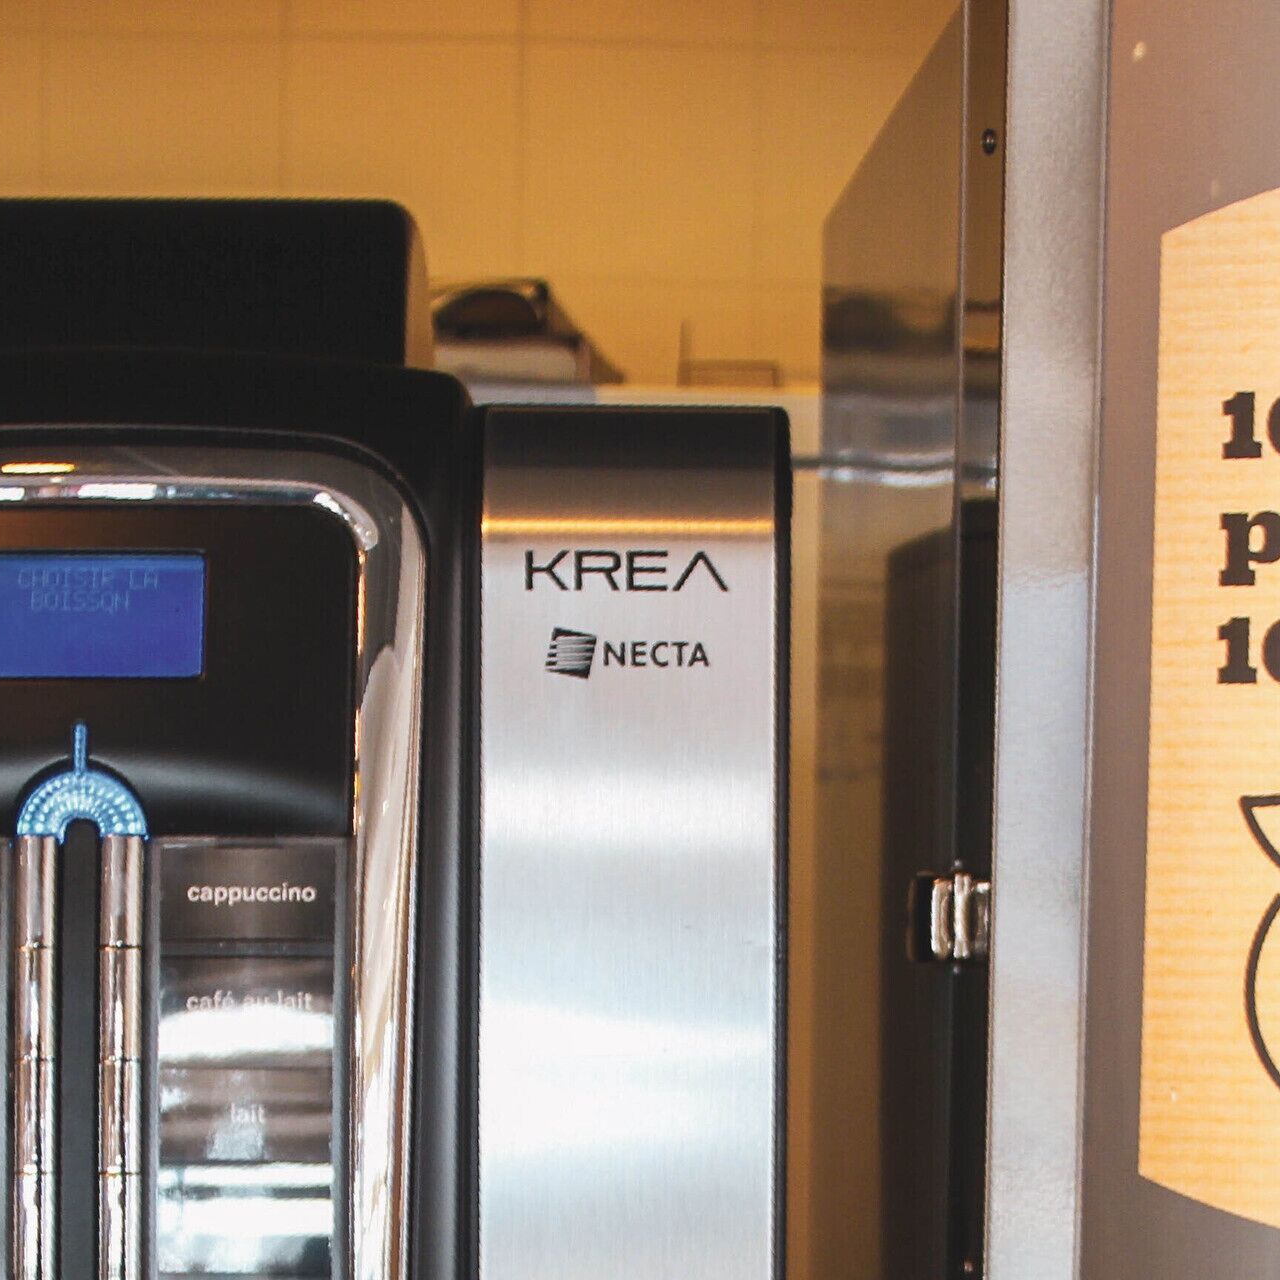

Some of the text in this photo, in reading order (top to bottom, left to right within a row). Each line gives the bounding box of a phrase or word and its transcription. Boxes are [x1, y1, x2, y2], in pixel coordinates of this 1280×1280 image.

[524, 550, 729, 592] KREA
[31, 590, 130, 614] BOISSON
[603, 640, 709, 668] NECTA
[186, 882, 317, 904] cappuccino
[186, 989, 235, 1011] café
[277, 989, 313, 1011] lait
[231, 1102, 266, 1124] lait
